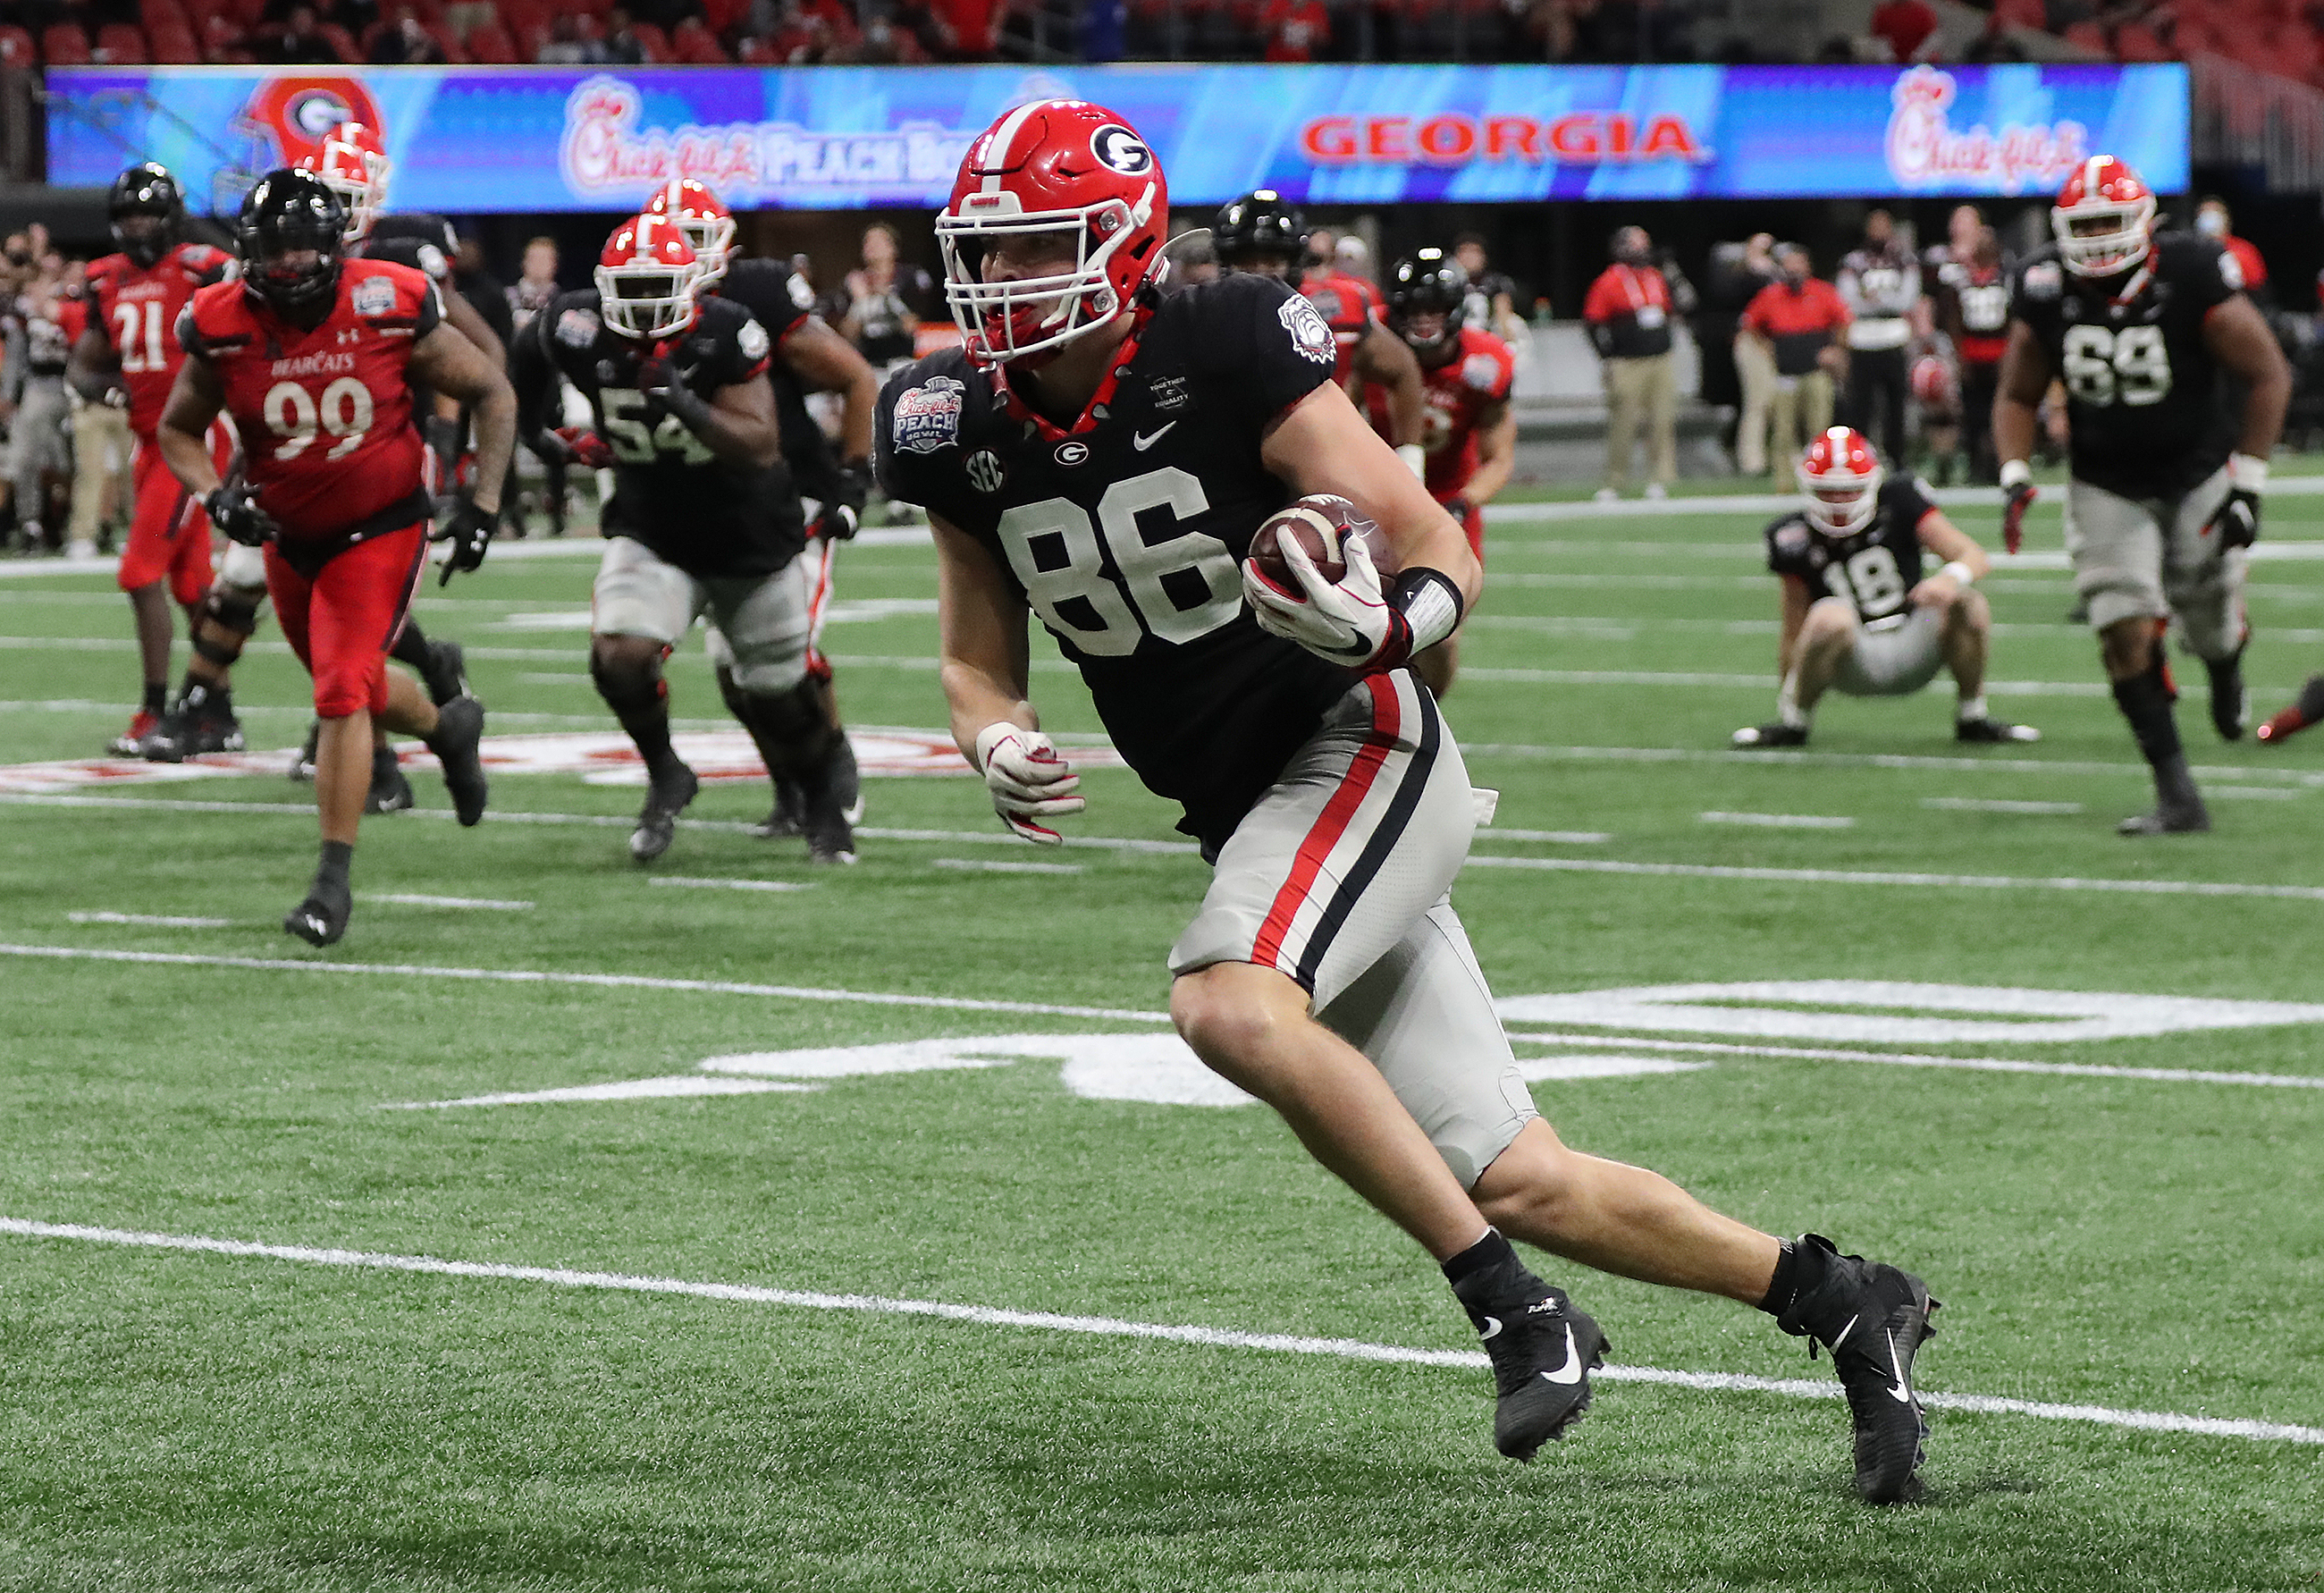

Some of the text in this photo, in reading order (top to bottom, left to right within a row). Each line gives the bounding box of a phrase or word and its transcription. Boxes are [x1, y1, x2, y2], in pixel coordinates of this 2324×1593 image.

[763, 131, 899, 181] PEACH
[1300, 114, 1700, 161] GEORGIA
[113, 300, 166, 373] 21
[271, 350, 355, 377] BEARCATS
[1149, 376, 1186, 392] TOGETHER
[2062, 324, 2173, 408] 69
[264, 376, 374, 462] 99
[1154, 393, 1189, 409] EQUALITY
[598, 387, 714, 466] 54
[897, 413, 956, 440] PEACH
[905, 430, 943, 441] BOWL
[965, 450, 1004, 492] SEC
[997, 466, 1245, 656] 86
[1822, 544, 1907, 617] 18
